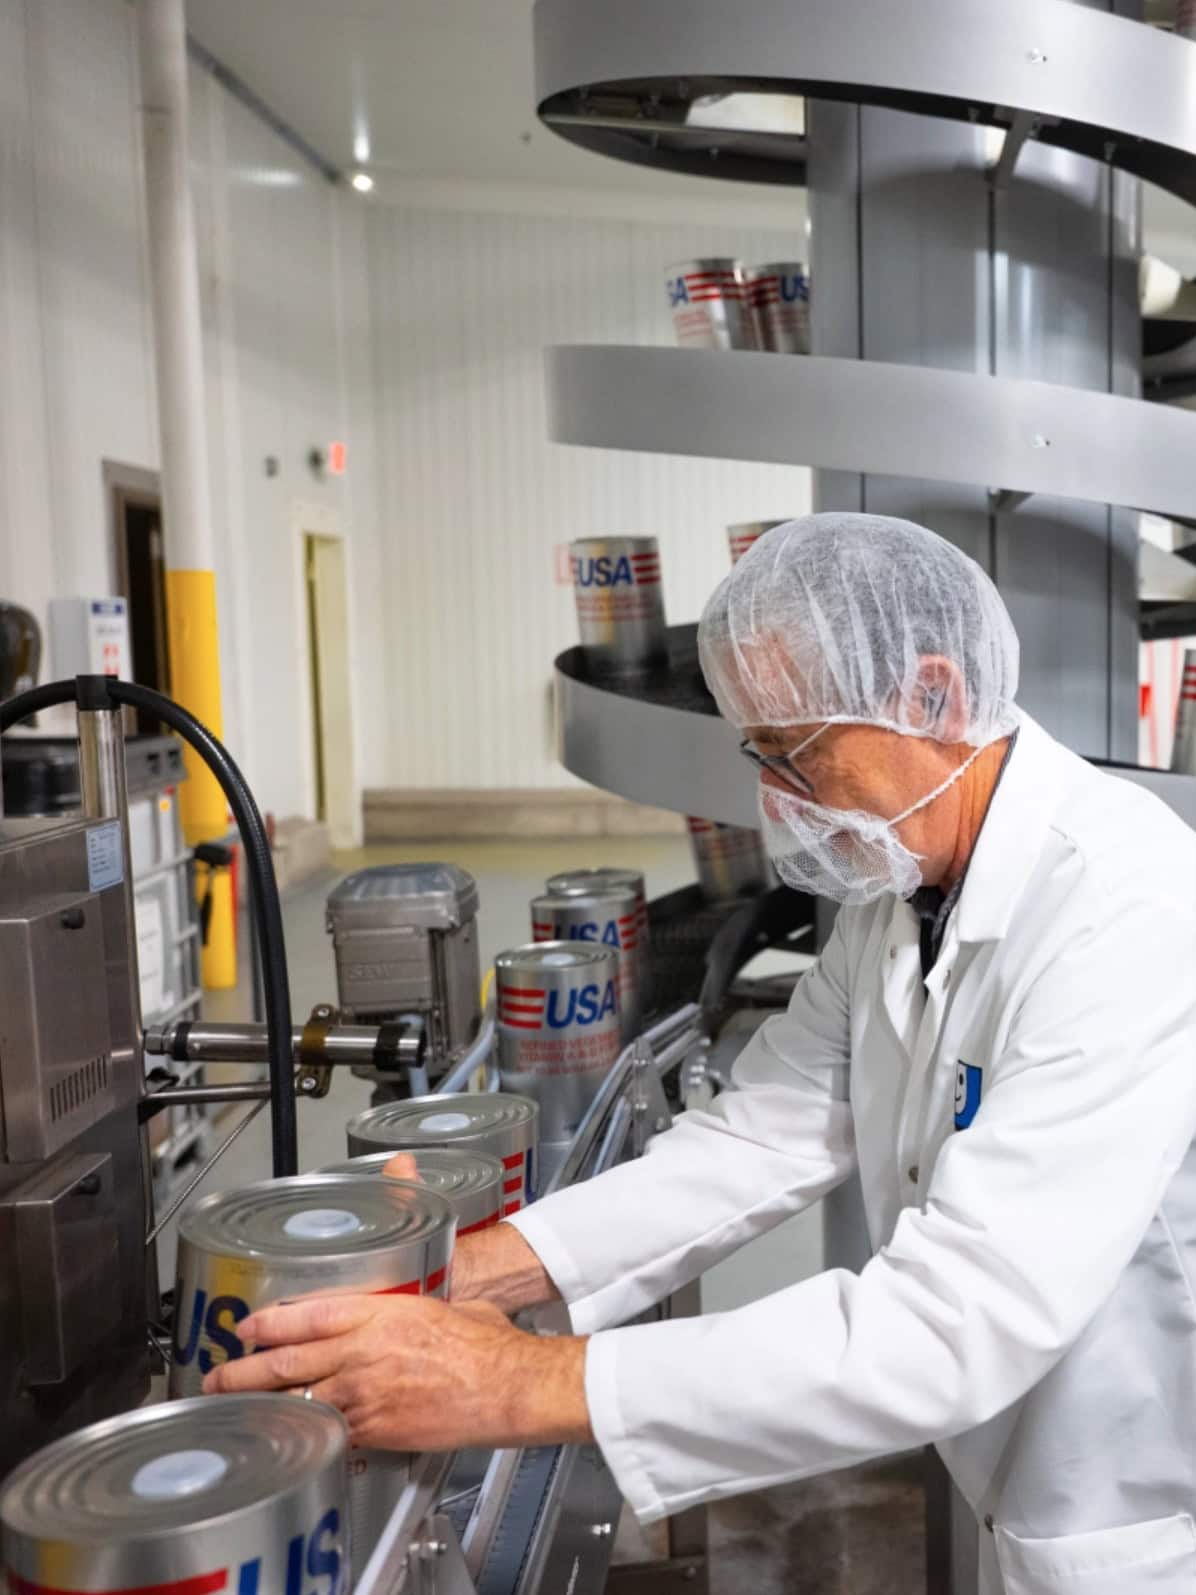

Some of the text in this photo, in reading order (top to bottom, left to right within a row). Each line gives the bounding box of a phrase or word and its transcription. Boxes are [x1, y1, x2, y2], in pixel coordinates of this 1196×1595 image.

[577, 556, 634, 587] USA
[546, 979, 617, 1030] USA
[175, 1289, 288, 1376] US
